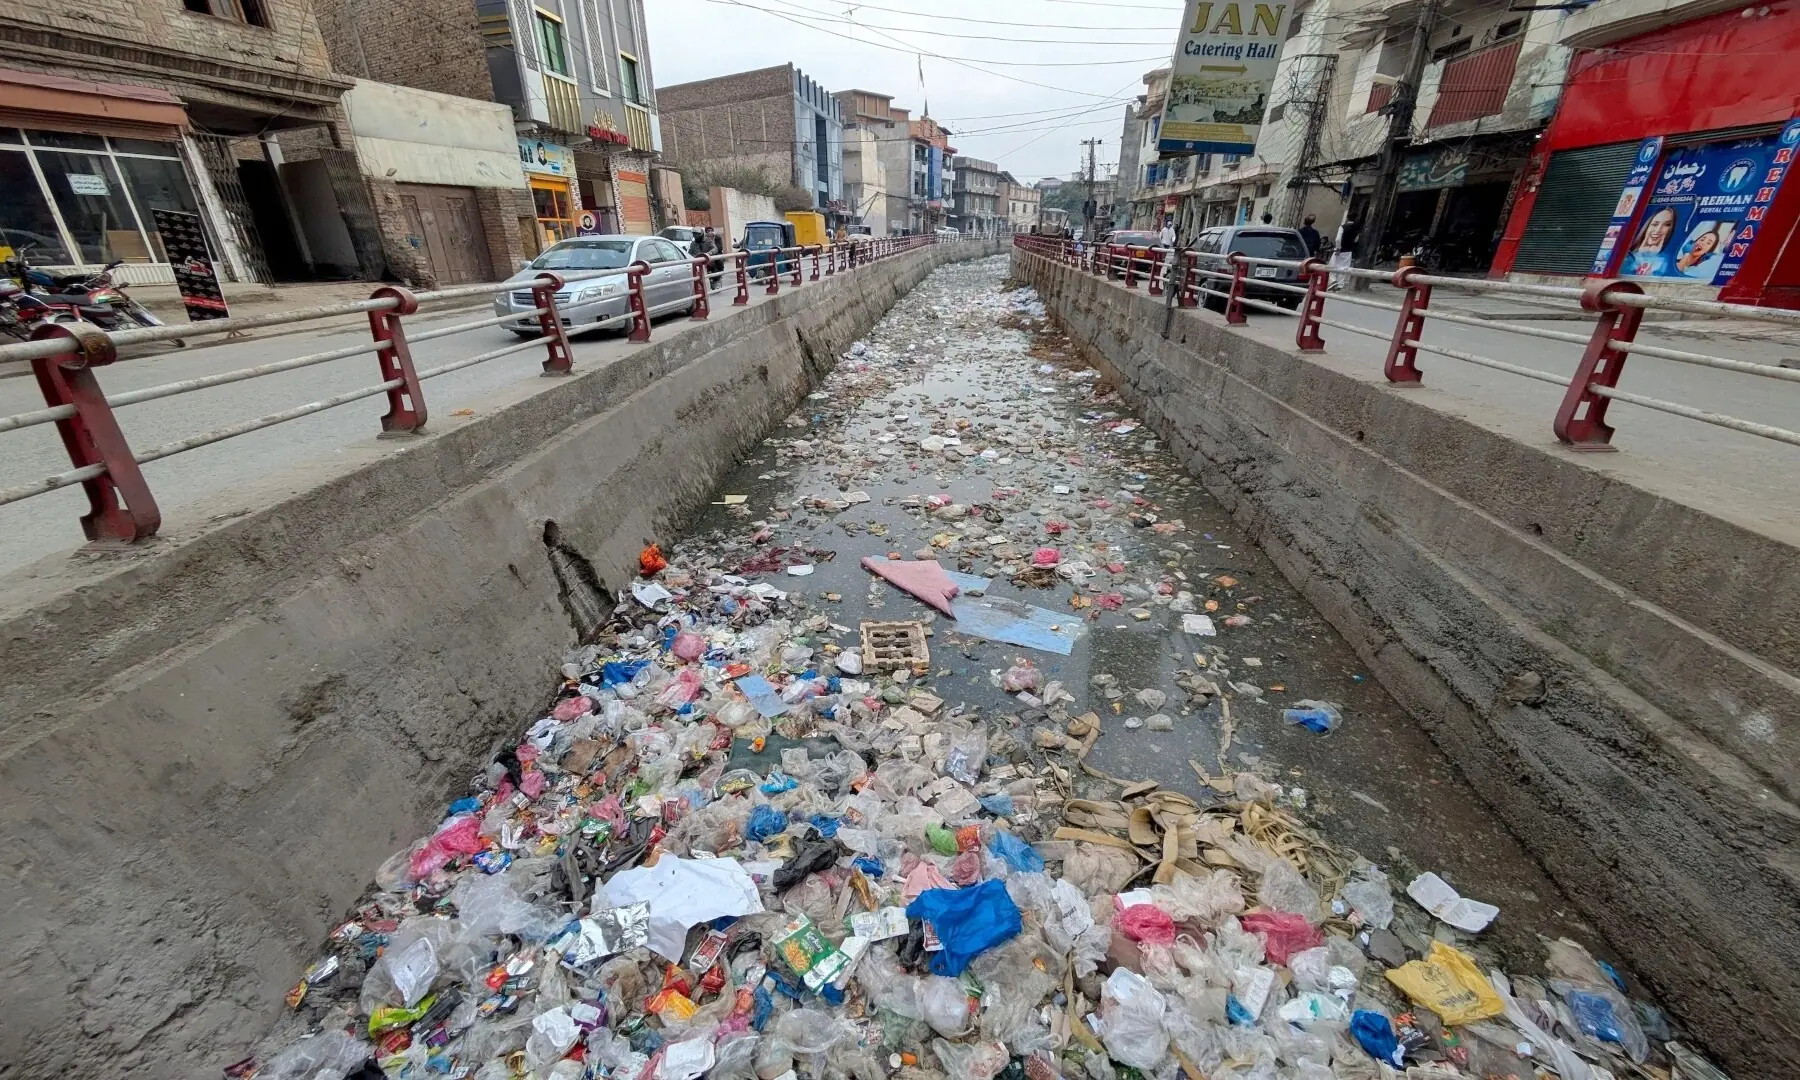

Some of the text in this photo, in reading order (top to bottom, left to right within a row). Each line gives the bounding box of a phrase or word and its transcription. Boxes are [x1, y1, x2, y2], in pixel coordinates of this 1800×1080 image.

[1190, 2, 1286, 35] JAN
[1184, 40, 1278, 60] Catering Hall
[1664, 161, 1706, 179] رحمان
[1700, 195, 1754, 206] REHMAN
